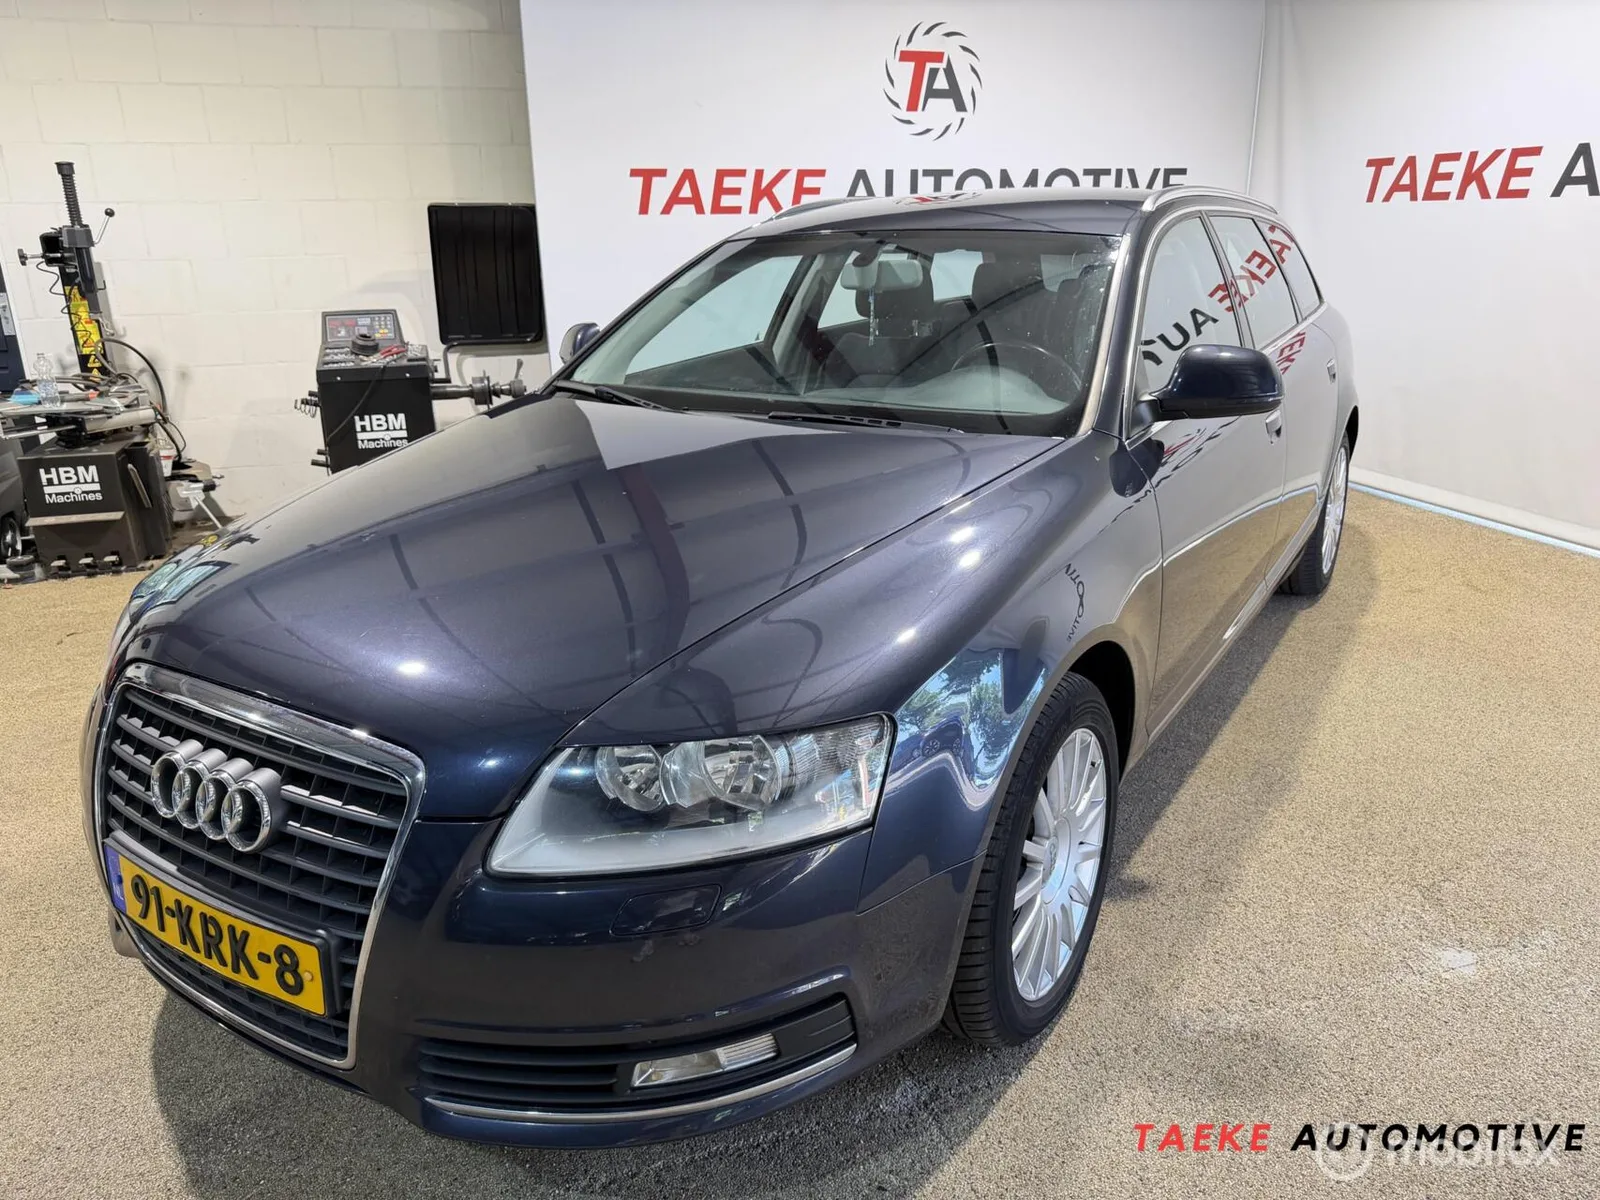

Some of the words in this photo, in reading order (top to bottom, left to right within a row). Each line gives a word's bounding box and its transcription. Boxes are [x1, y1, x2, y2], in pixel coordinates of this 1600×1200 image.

[898, 50, 968, 112] TA
[1365, 145, 1544, 203] TAEKE
[629, 168, 827, 215] TAEKE
[354, 412, 407, 432] HBM
[358, 438, 408, 449] Machines
[39, 464, 99, 485] HBM
[45, 491, 103, 504] Machines
[131, 873, 305, 996] 91-KRK-8
